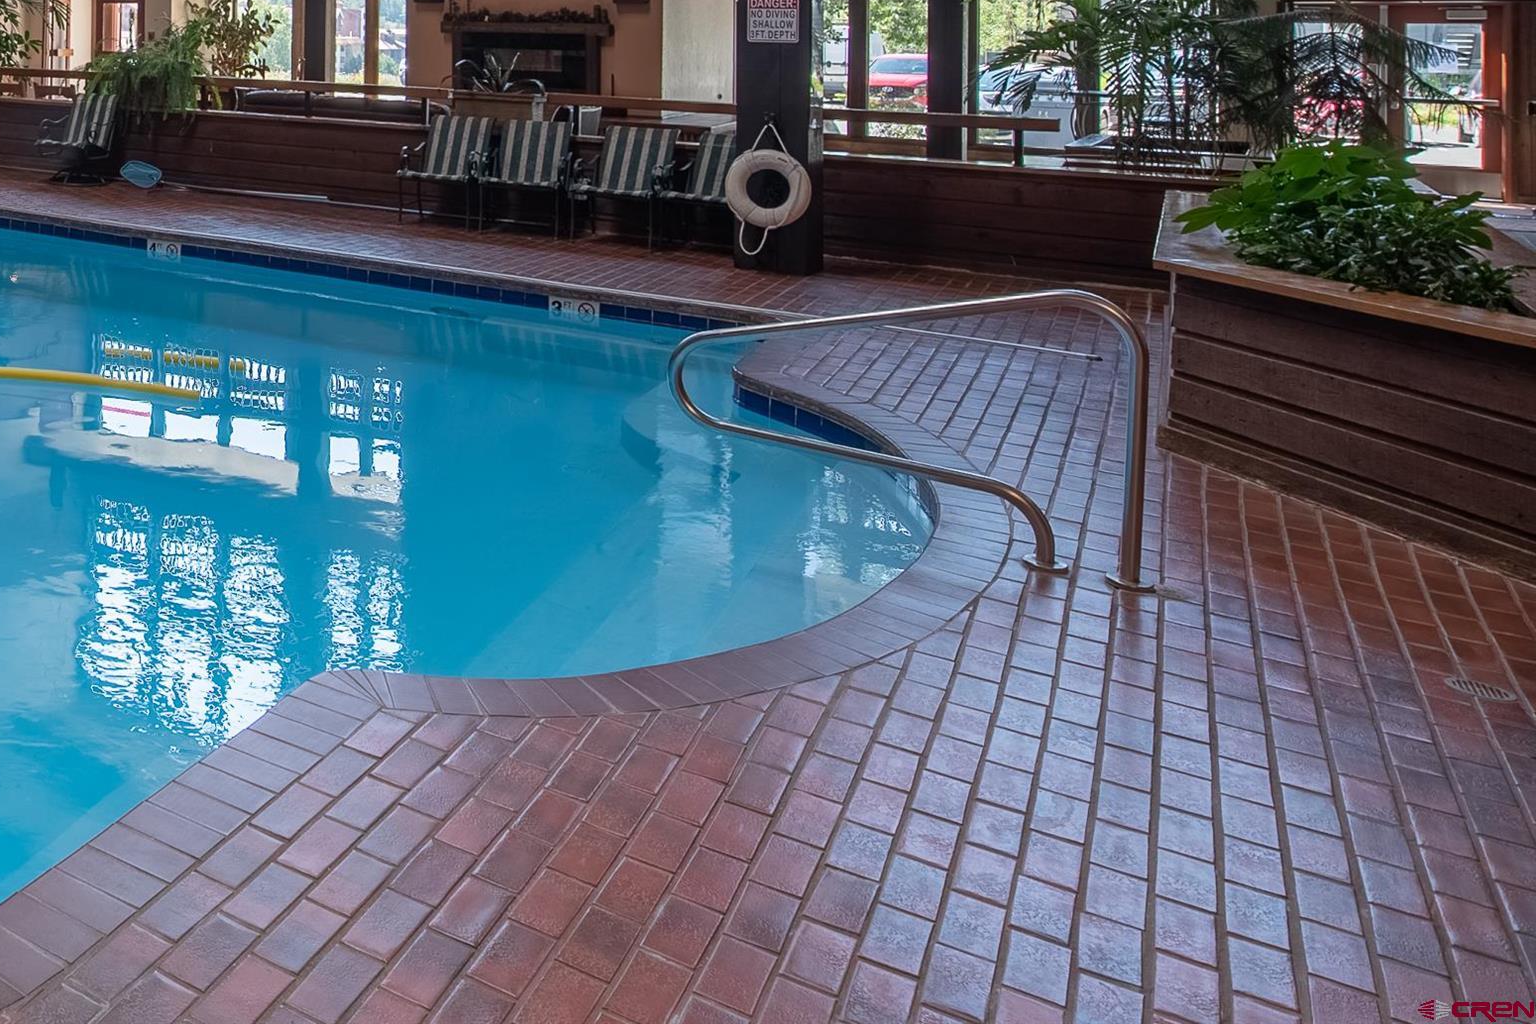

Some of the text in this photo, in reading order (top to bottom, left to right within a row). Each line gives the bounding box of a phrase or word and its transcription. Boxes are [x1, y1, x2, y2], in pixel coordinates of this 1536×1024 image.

[751, 10, 796, 18] NO DIVING
[752, 20, 794, 29] SHALLOW
